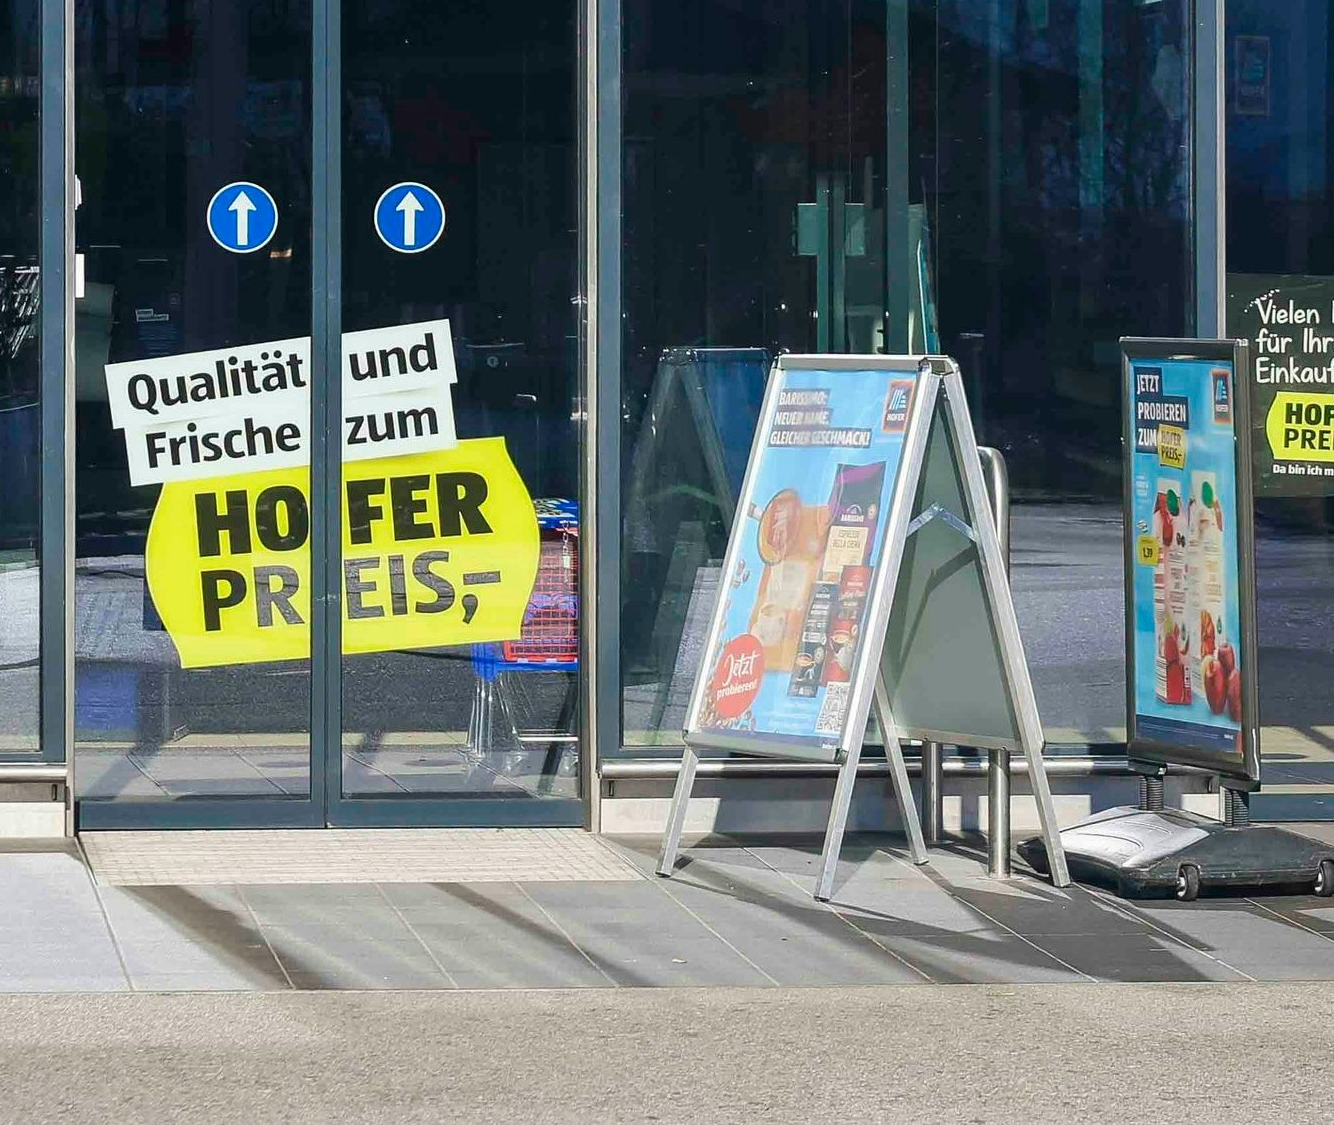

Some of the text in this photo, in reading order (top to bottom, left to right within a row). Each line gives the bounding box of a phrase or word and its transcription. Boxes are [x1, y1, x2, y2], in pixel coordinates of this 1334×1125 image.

[1256, 298, 1320, 325] Vielen
[1255, 328, 1293, 354] für
[127, 333, 439, 415] Qualität und
[1136, 374, 1160, 395] JETZT
[774, 411, 803, 426] NEUER
[886, 413, 906, 422] HOFER
[1137, 401, 1187, 422] PROBIEREN
[145, 406, 439, 469] Frische zum
[770, 430, 871, 446] GLEICHER GESCHMACK!
[1138, 427, 1157, 447] ZUM
[1161, 430, 1182, 446] HOFER
[1272, 463, 1286, 475] Da
[1287, 463, 1305, 476] bin
[1306, 464, 1323, 476] ich
[194, 471, 494, 558] HOFER
[199, 551, 502, 633] PREIS,-
[722, 650, 761, 686] Jetzt
